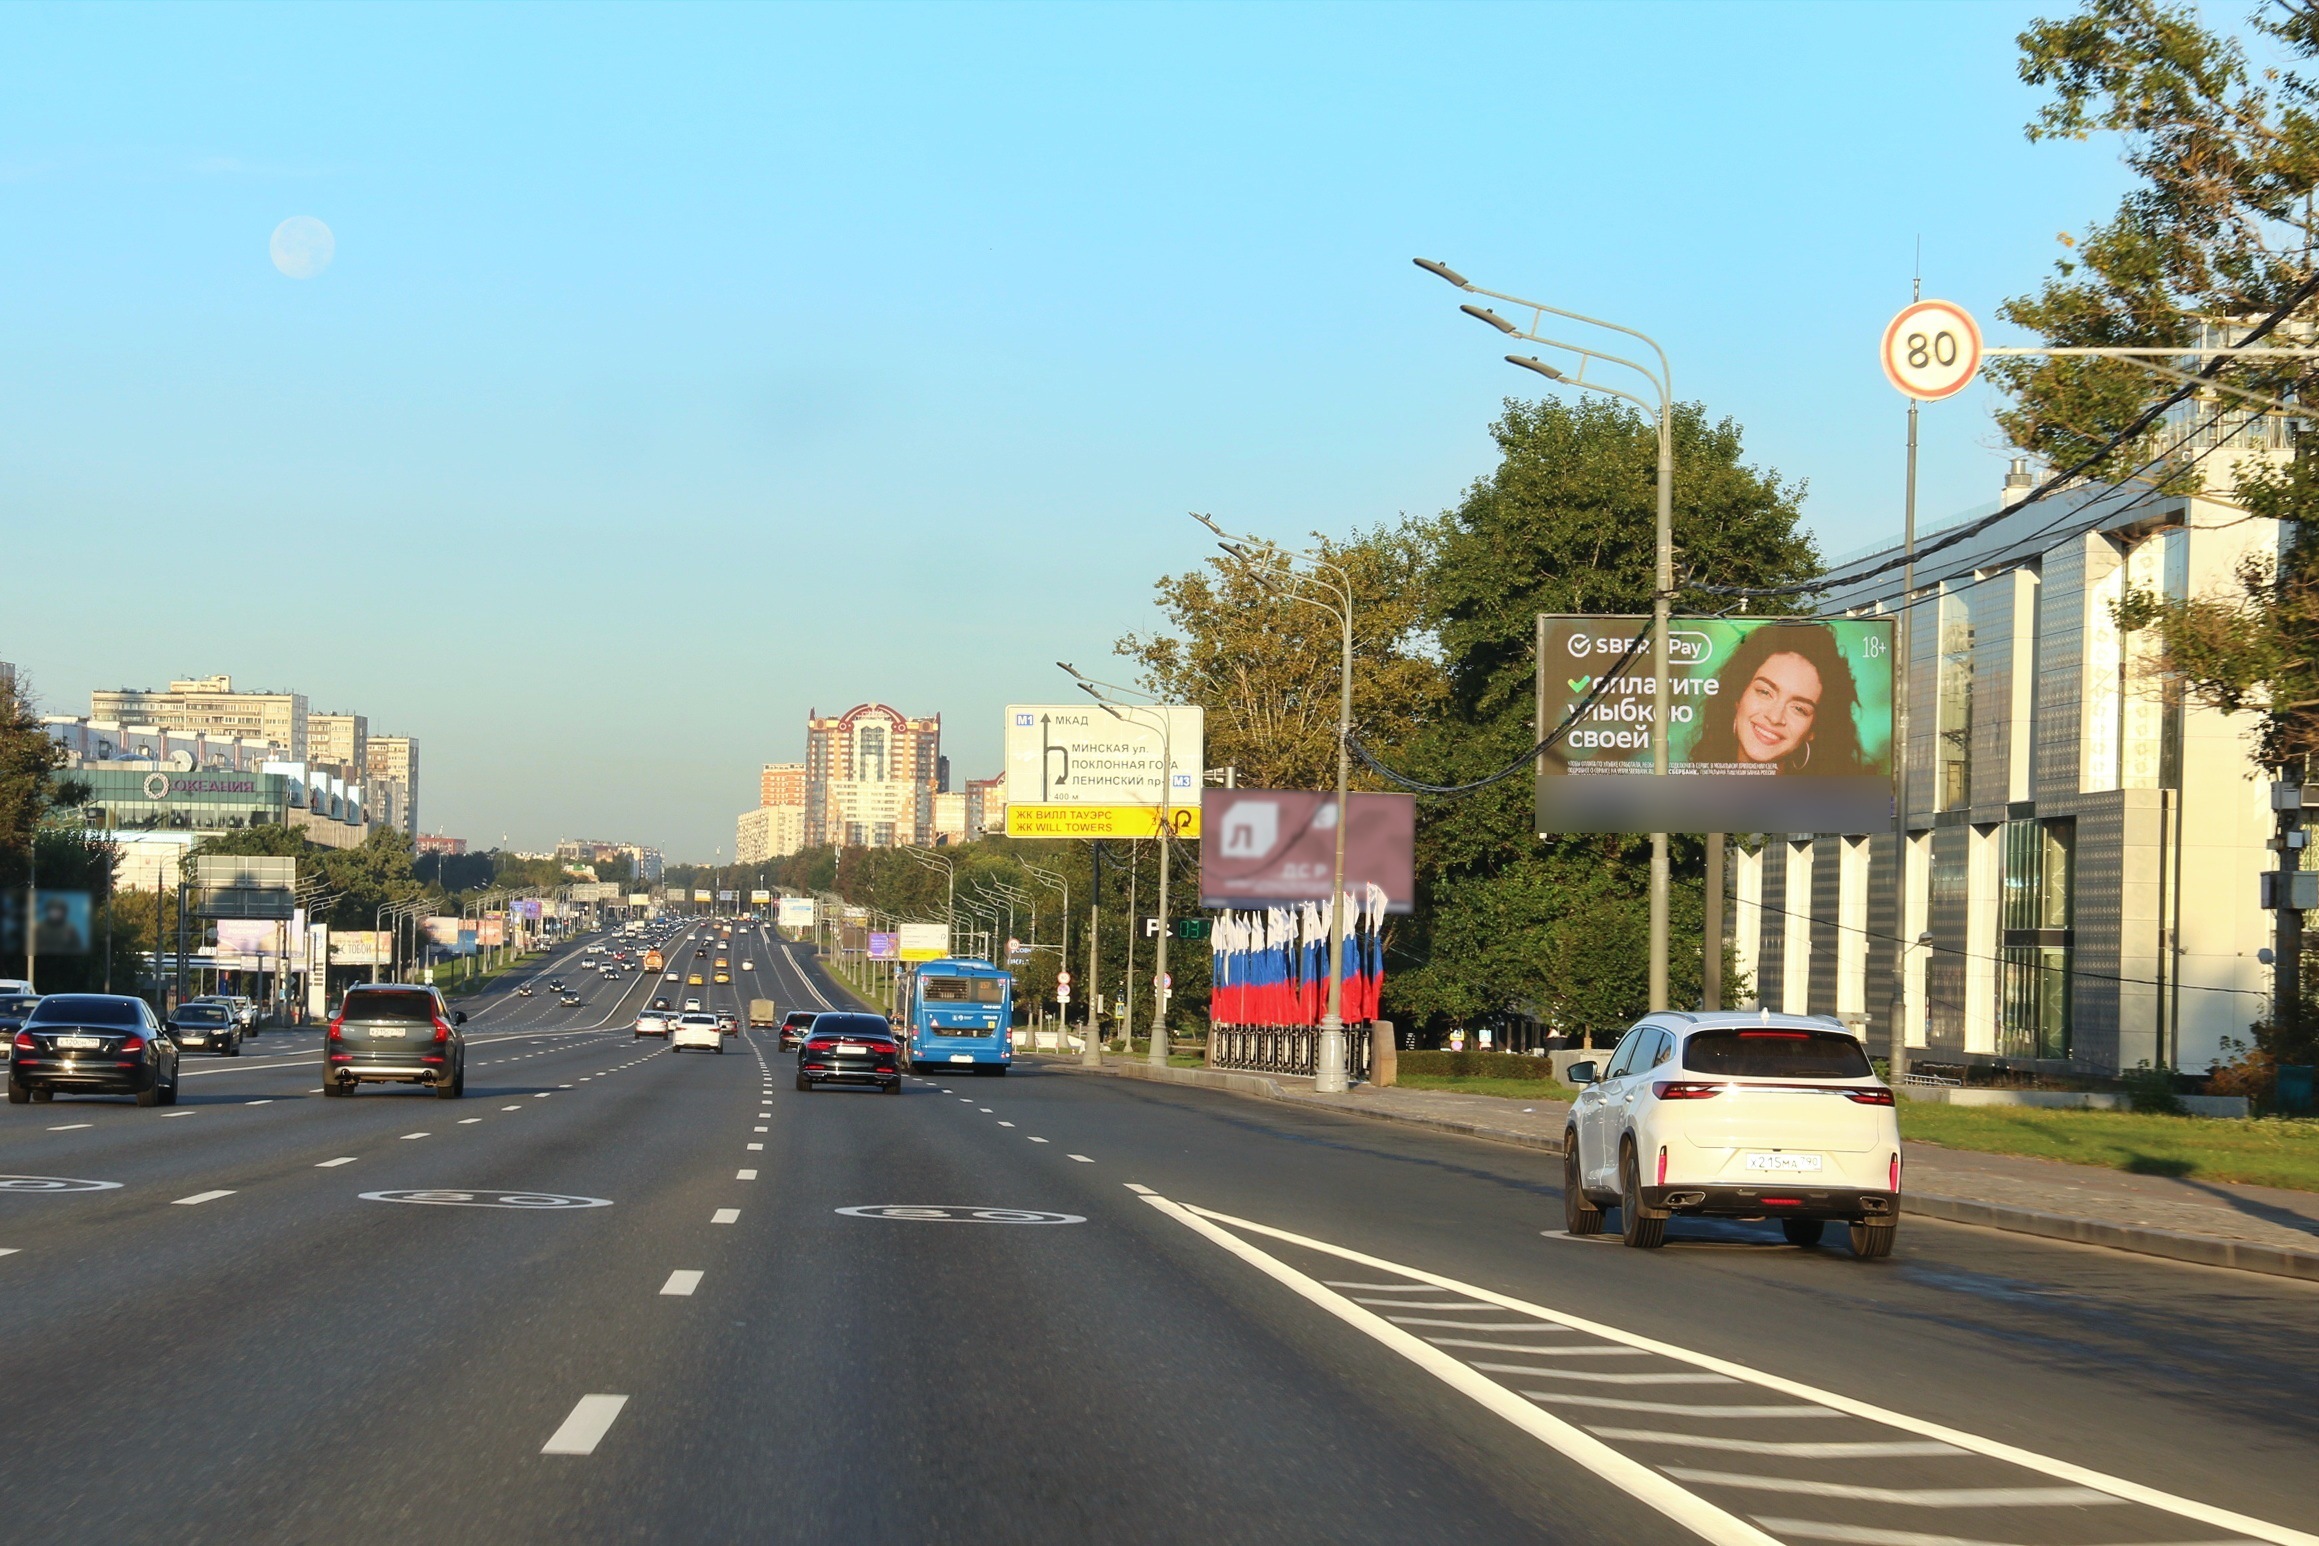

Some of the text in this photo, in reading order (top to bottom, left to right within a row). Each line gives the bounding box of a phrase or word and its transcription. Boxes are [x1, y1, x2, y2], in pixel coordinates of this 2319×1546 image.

[1907, 331, 1957, 369] 80
[1669, 638, 1702, 659] Pay
[1862, 636, 1887, 658] 18+
[1592, 676, 1720, 695] оплаите
[1017, 715, 1088, 726] М1 МКАД
[1568, 724, 1649, 749] своей
[1071, 744, 1149, 755] МИНСКАЯ ул.
[1071, 760, 1179, 770] ПОКЛОННАЯ ГОА
[1072, 775, 1144, 785] ЛЕНИНСКИЙ
[173, 780, 256, 792] ОКЕАНИЯ
[1016, 811, 1112, 819] ЖК ВИЛЛ ТАУЭРС
[1016, 823, 1112, 832] ЖК WILL TOWERS
